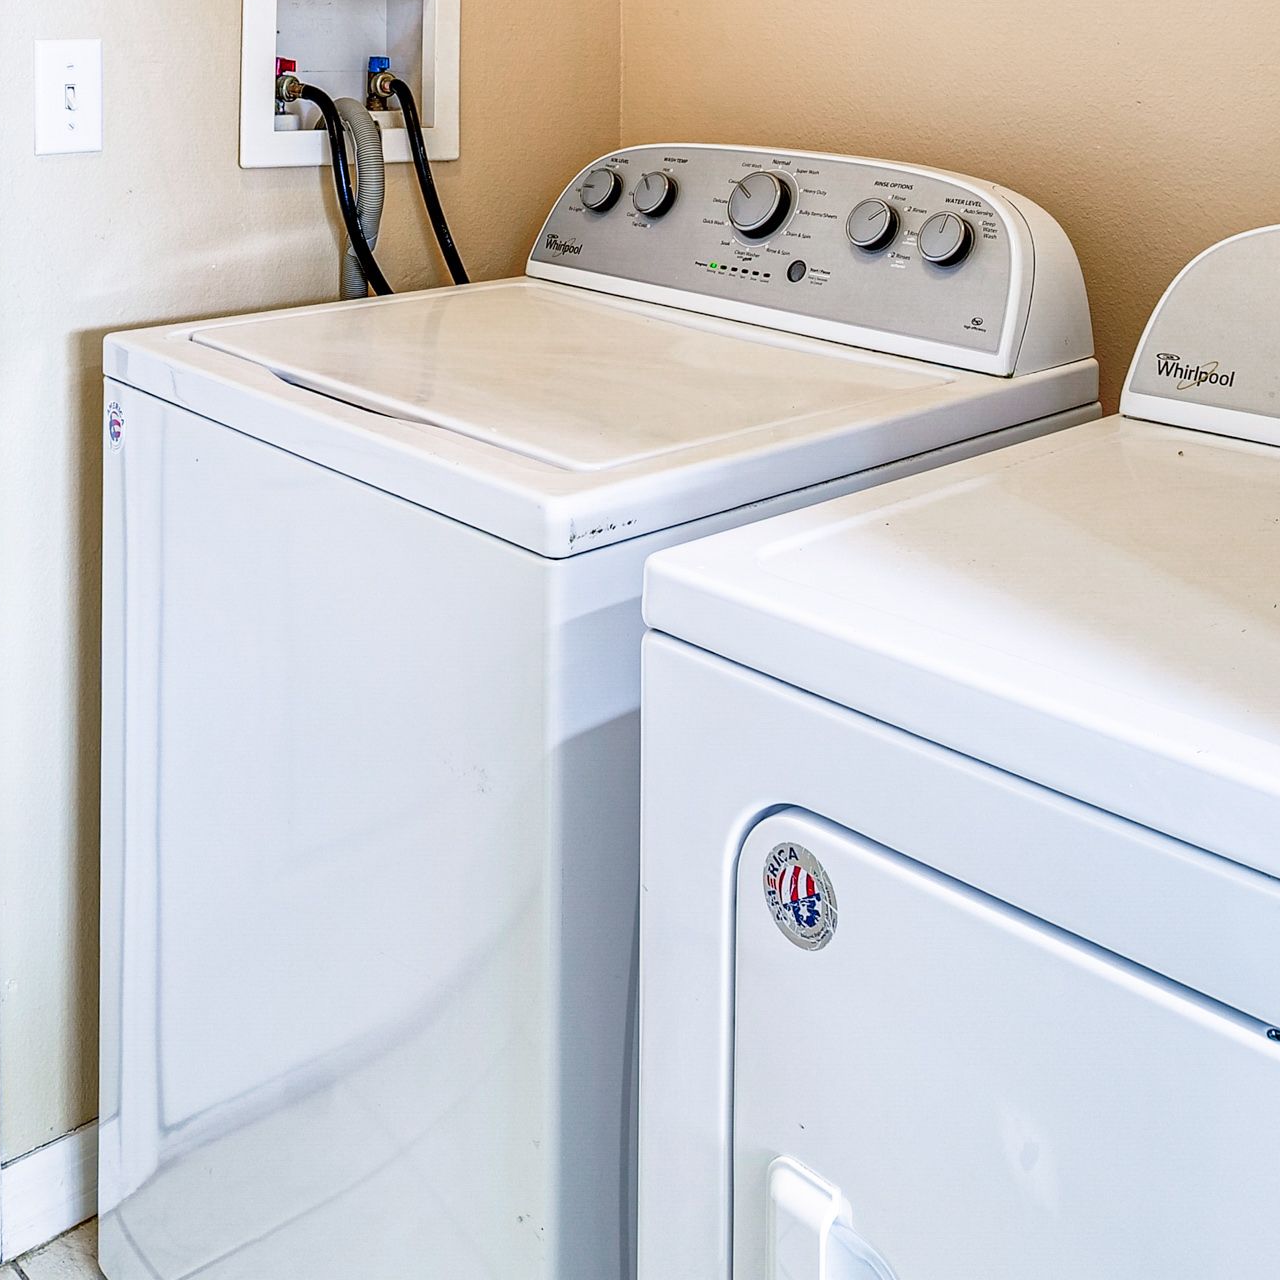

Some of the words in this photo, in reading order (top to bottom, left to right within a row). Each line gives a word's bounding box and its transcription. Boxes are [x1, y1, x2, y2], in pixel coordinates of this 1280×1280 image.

[889, 182, 914, 190] OPTIONS
[545, 238, 583, 255] Whirlpool
[1157, 359, 1236, 387] Whirlpool
